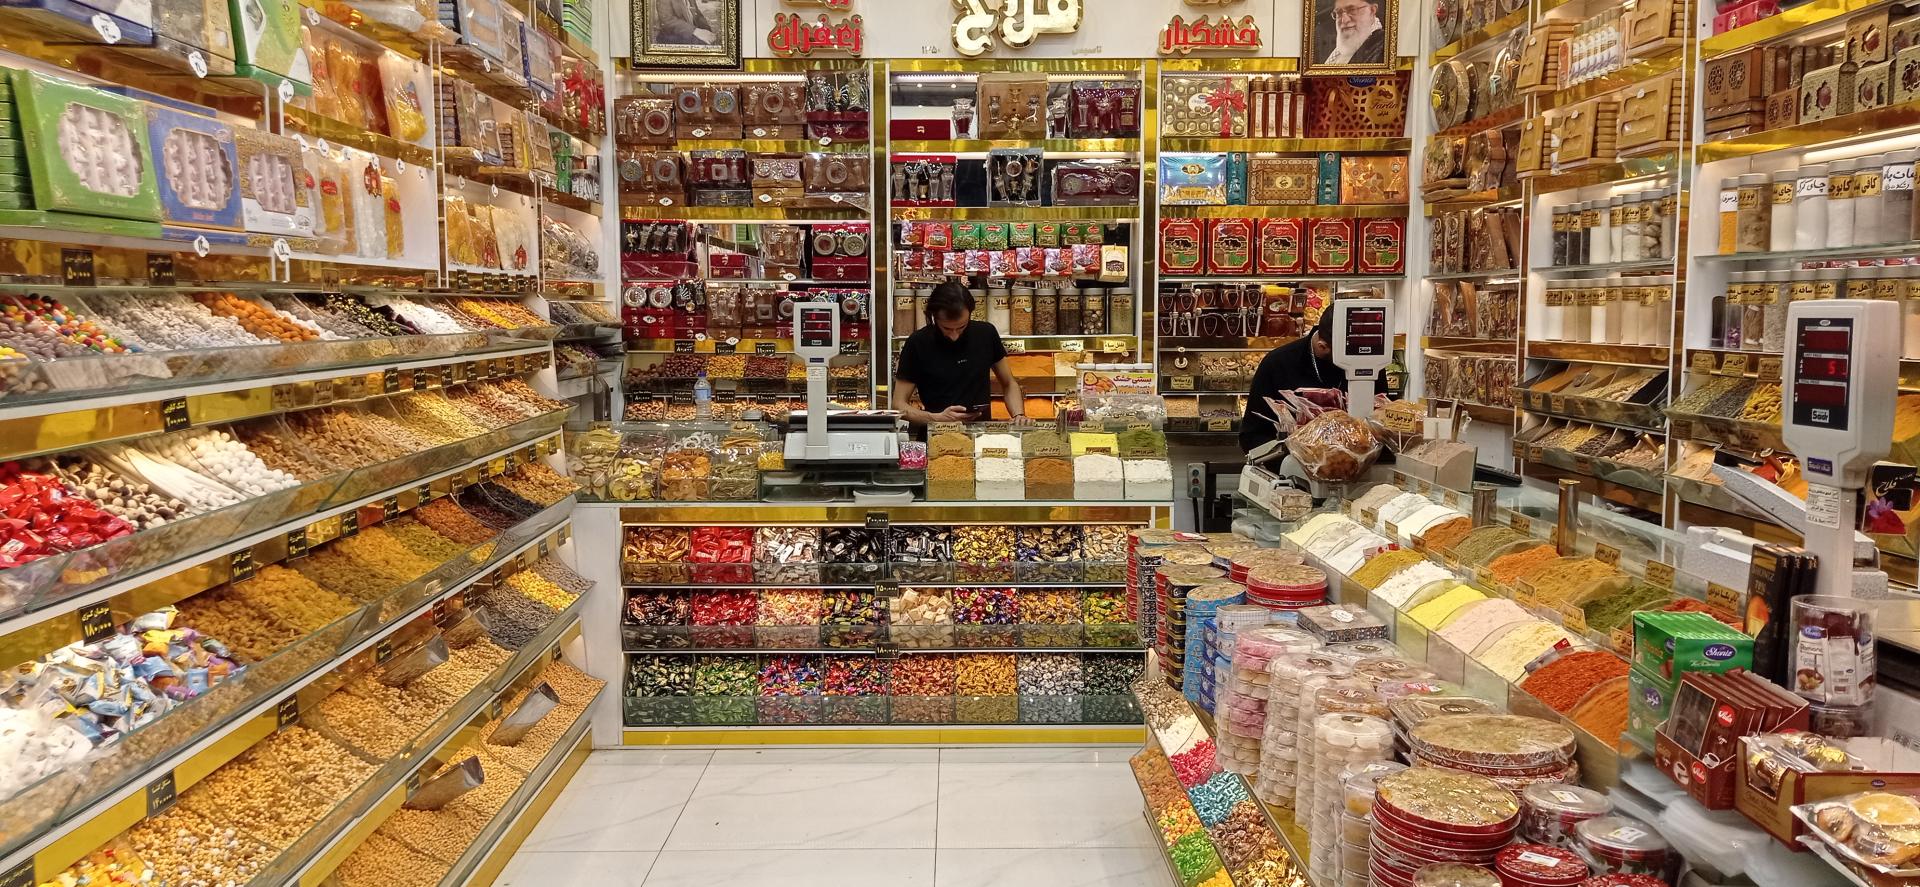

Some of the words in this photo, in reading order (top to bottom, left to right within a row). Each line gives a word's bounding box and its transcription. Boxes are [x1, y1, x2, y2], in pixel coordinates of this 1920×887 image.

[769, 14, 862, 53] زعفران
[1161, 15, 1260, 52] خشکبار
[1113, 374, 1132, 382] خشک
[1131, 376, 1152, 384] بستنی
[84, 622, 111, 637] ۱۸۰,۰۰۰
[1704, 646, 1734, 658] Shoniz
